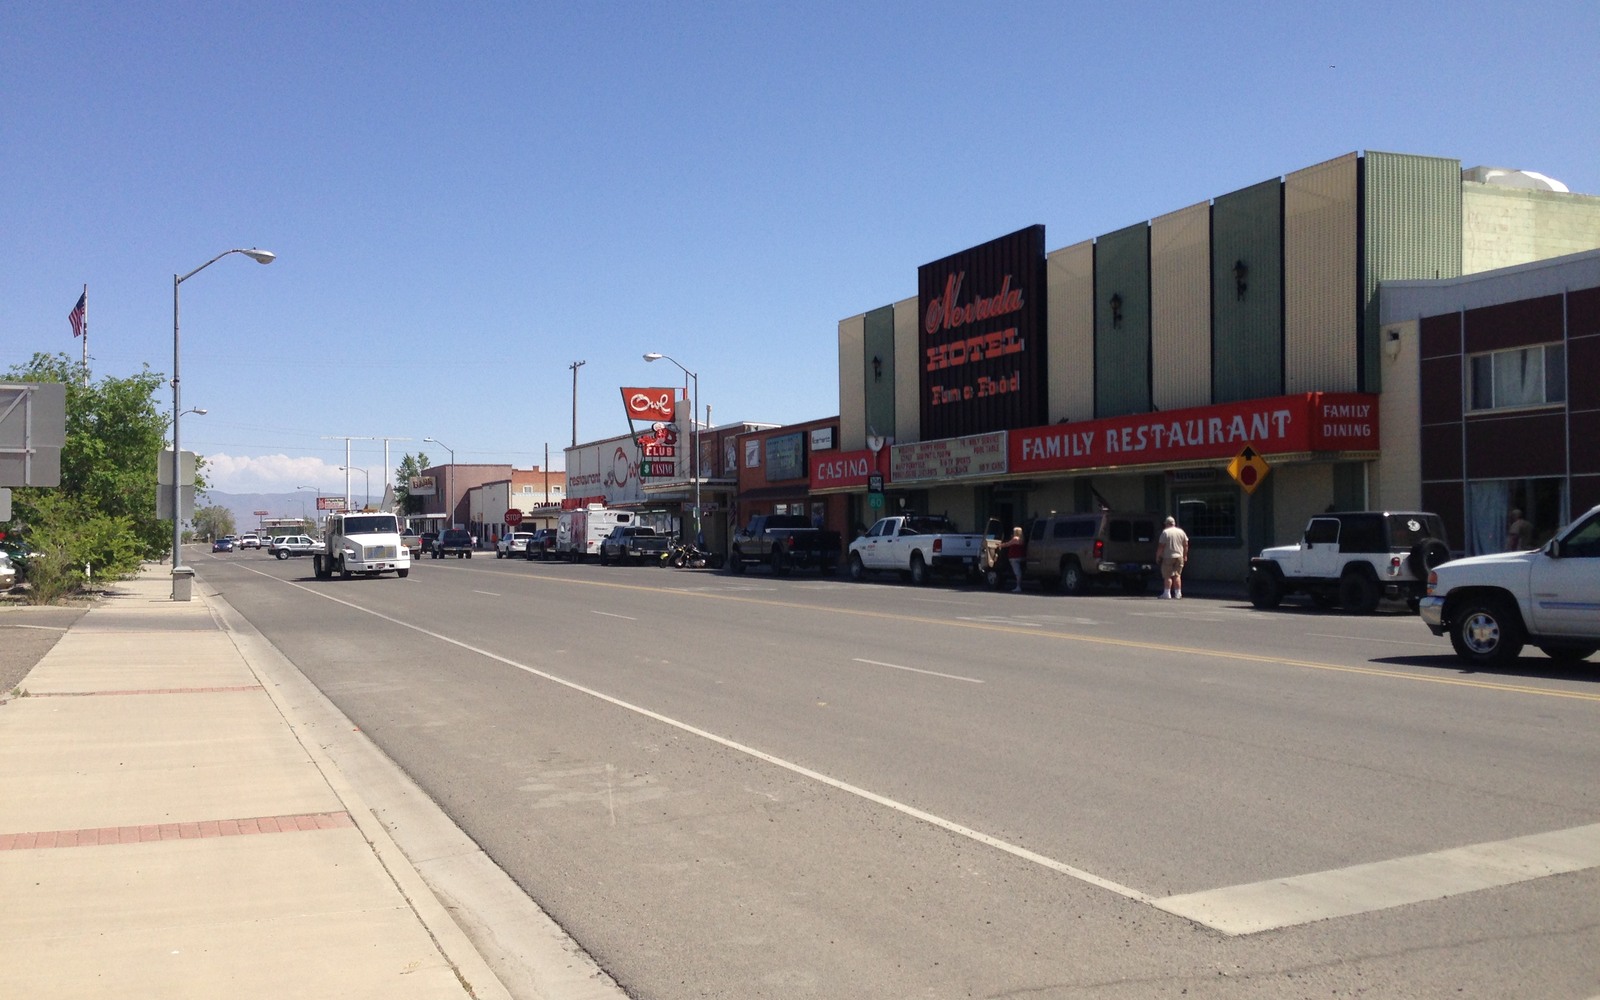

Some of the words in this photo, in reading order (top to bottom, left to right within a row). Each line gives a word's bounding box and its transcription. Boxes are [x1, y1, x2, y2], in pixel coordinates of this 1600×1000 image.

[925, 271, 1024, 334] Nevada
[927, 328, 1024, 372] HOTEL
[932, 385, 960, 405] Fun
[977, 370, 1020, 397] Food
[630, 393, 671, 414] Owl
[1323, 404, 1371, 418] FAMILY
[1022, 431, 1095, 461] FAMILY
[1106, 409, 1292, 453] RESTAURANT
[1323, 424, 1371, 437] DINING
[646, 447, 673, 456] CLUB
[651, 463, 673, 475] CASINO
[818, 457, 868, 480] CASINO
[569, 472, 601, 487] restaurant
